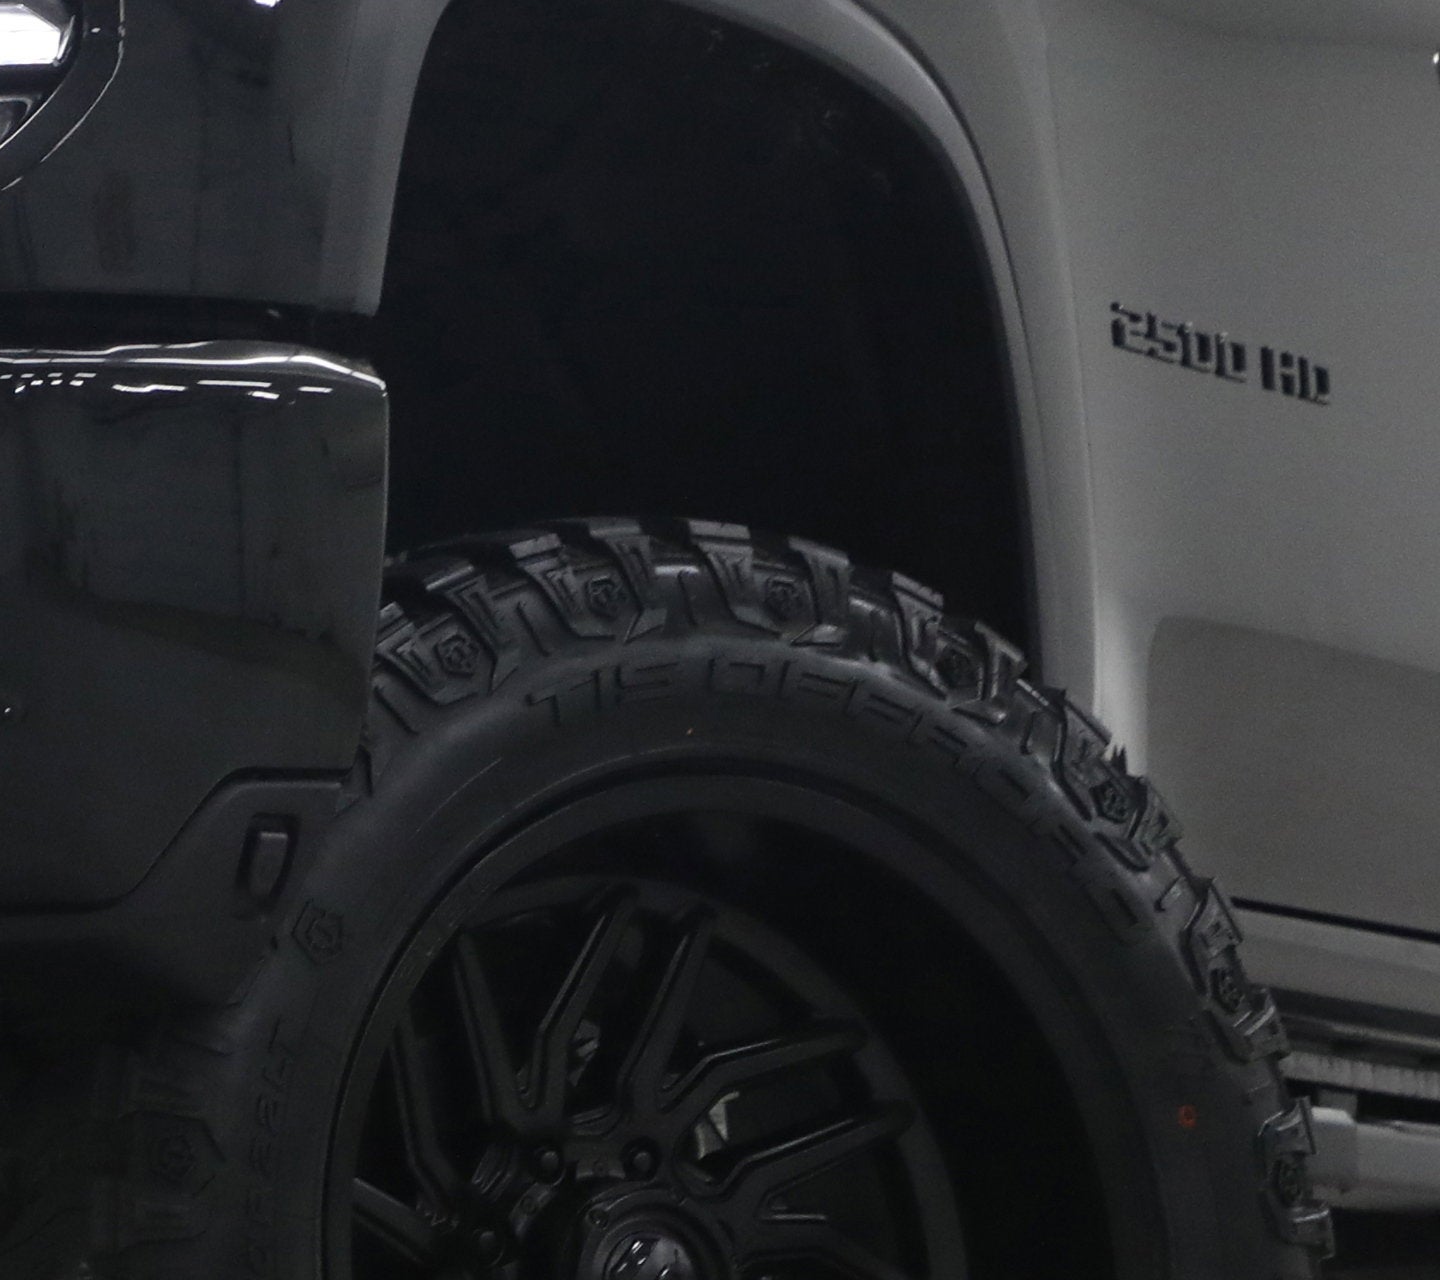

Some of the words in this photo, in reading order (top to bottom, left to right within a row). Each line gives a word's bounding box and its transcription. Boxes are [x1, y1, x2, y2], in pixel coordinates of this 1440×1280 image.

[1110, 302, 1247, 382] 2500
[1260, 345, 1331, 406] HD
[525, 656, 679, 726] TIS
[702, 654, 1142, 944] OFFROAD
